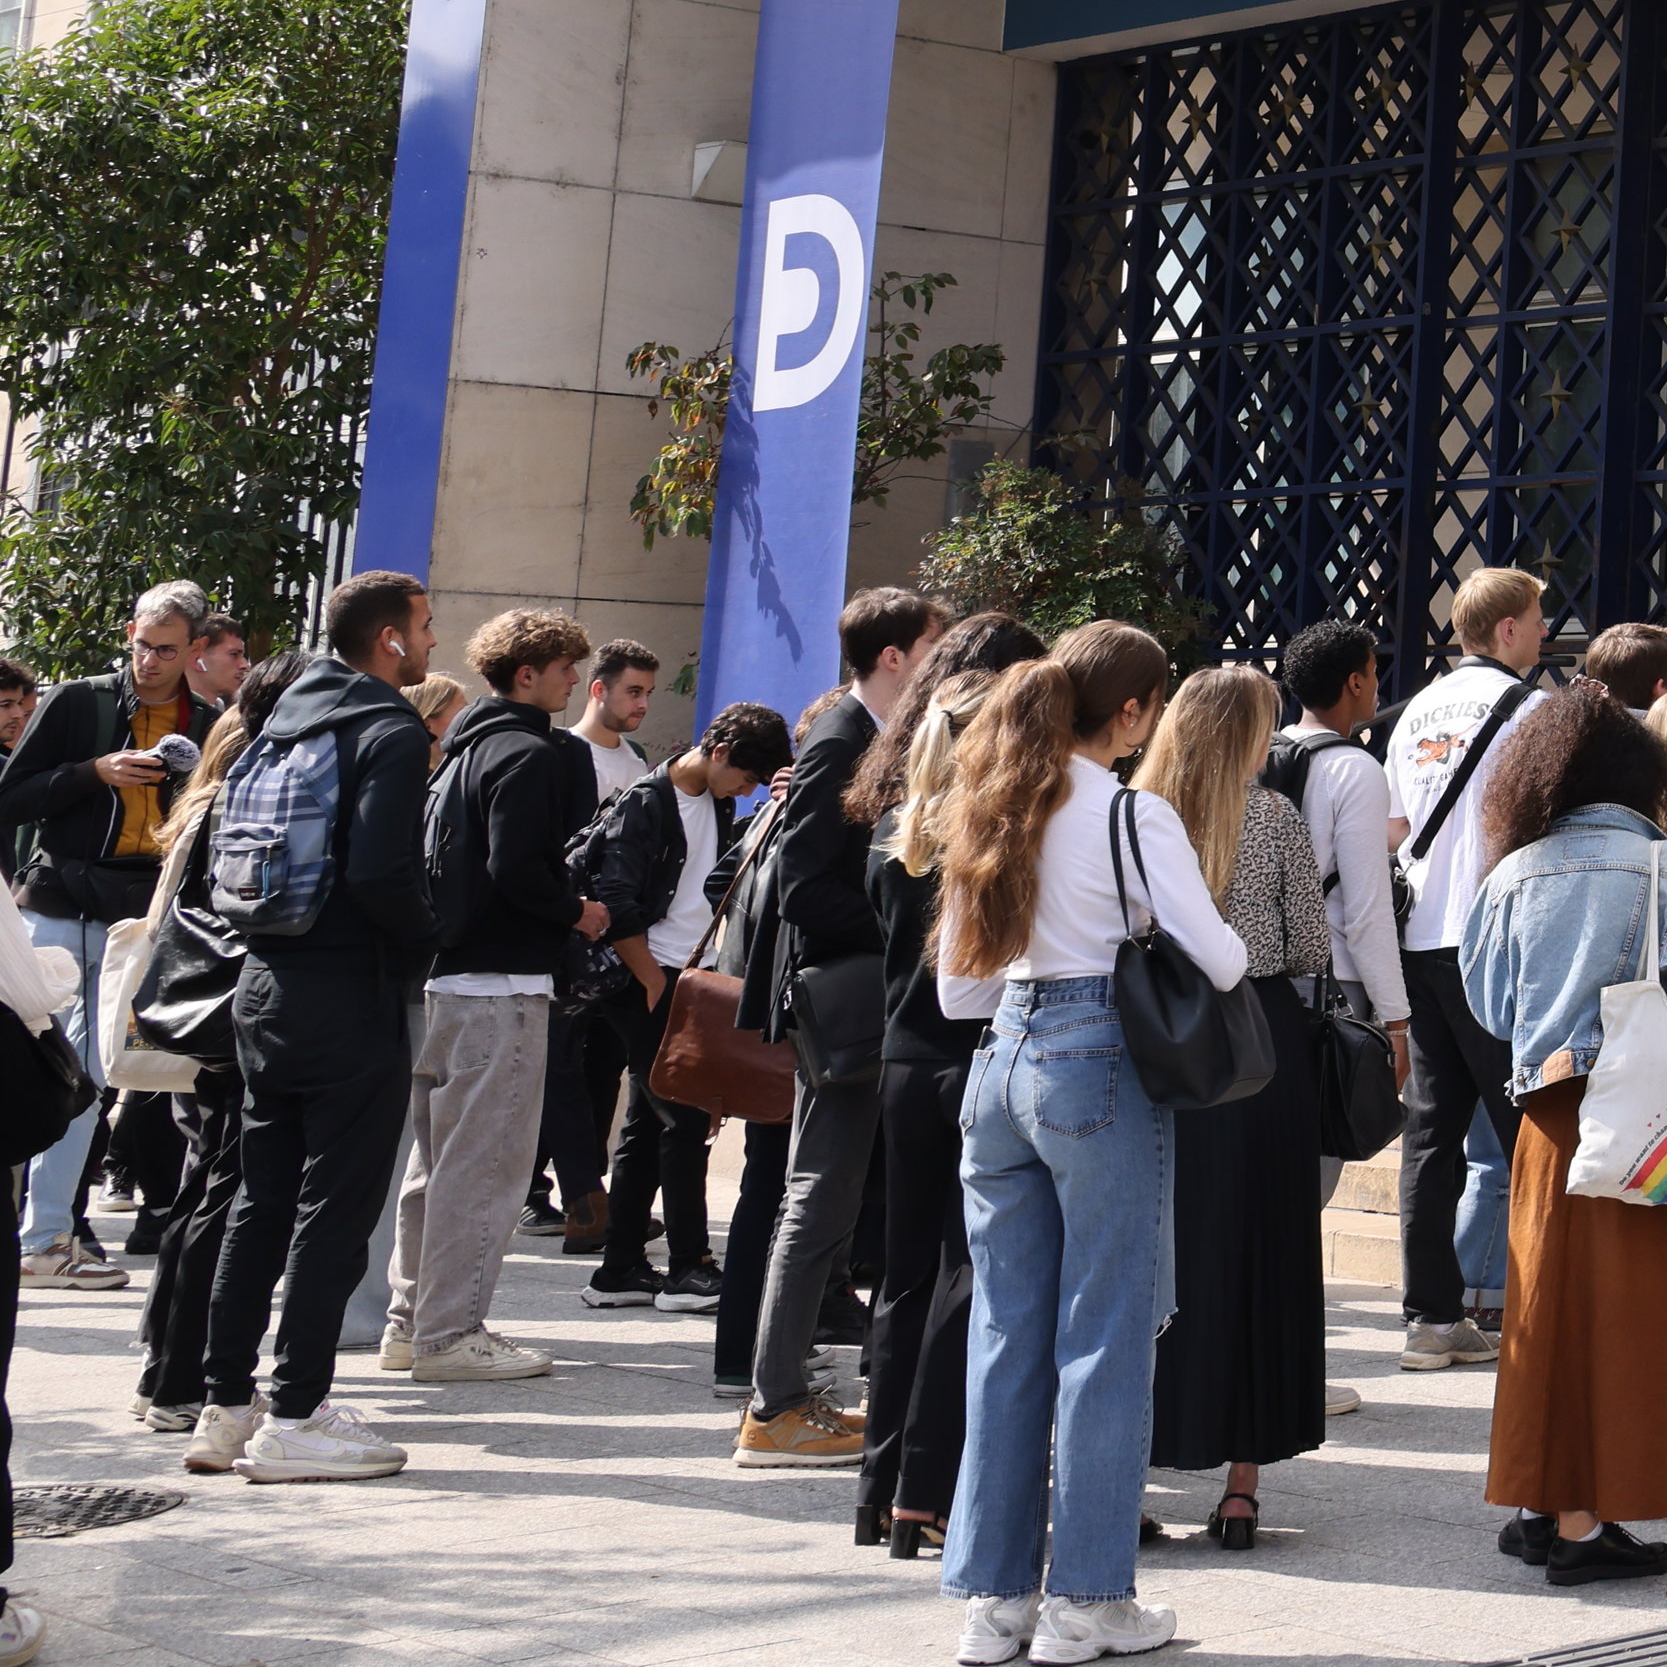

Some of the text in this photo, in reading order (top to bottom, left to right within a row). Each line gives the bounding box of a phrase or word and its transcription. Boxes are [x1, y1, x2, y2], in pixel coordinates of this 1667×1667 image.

[1409, 700, 1491, 737] DICKIES
[1626, 1163, 1637, 1177] you
[1635, 1145, 1650, 1164] want
[1647, 1138, 1656, 1148] to
